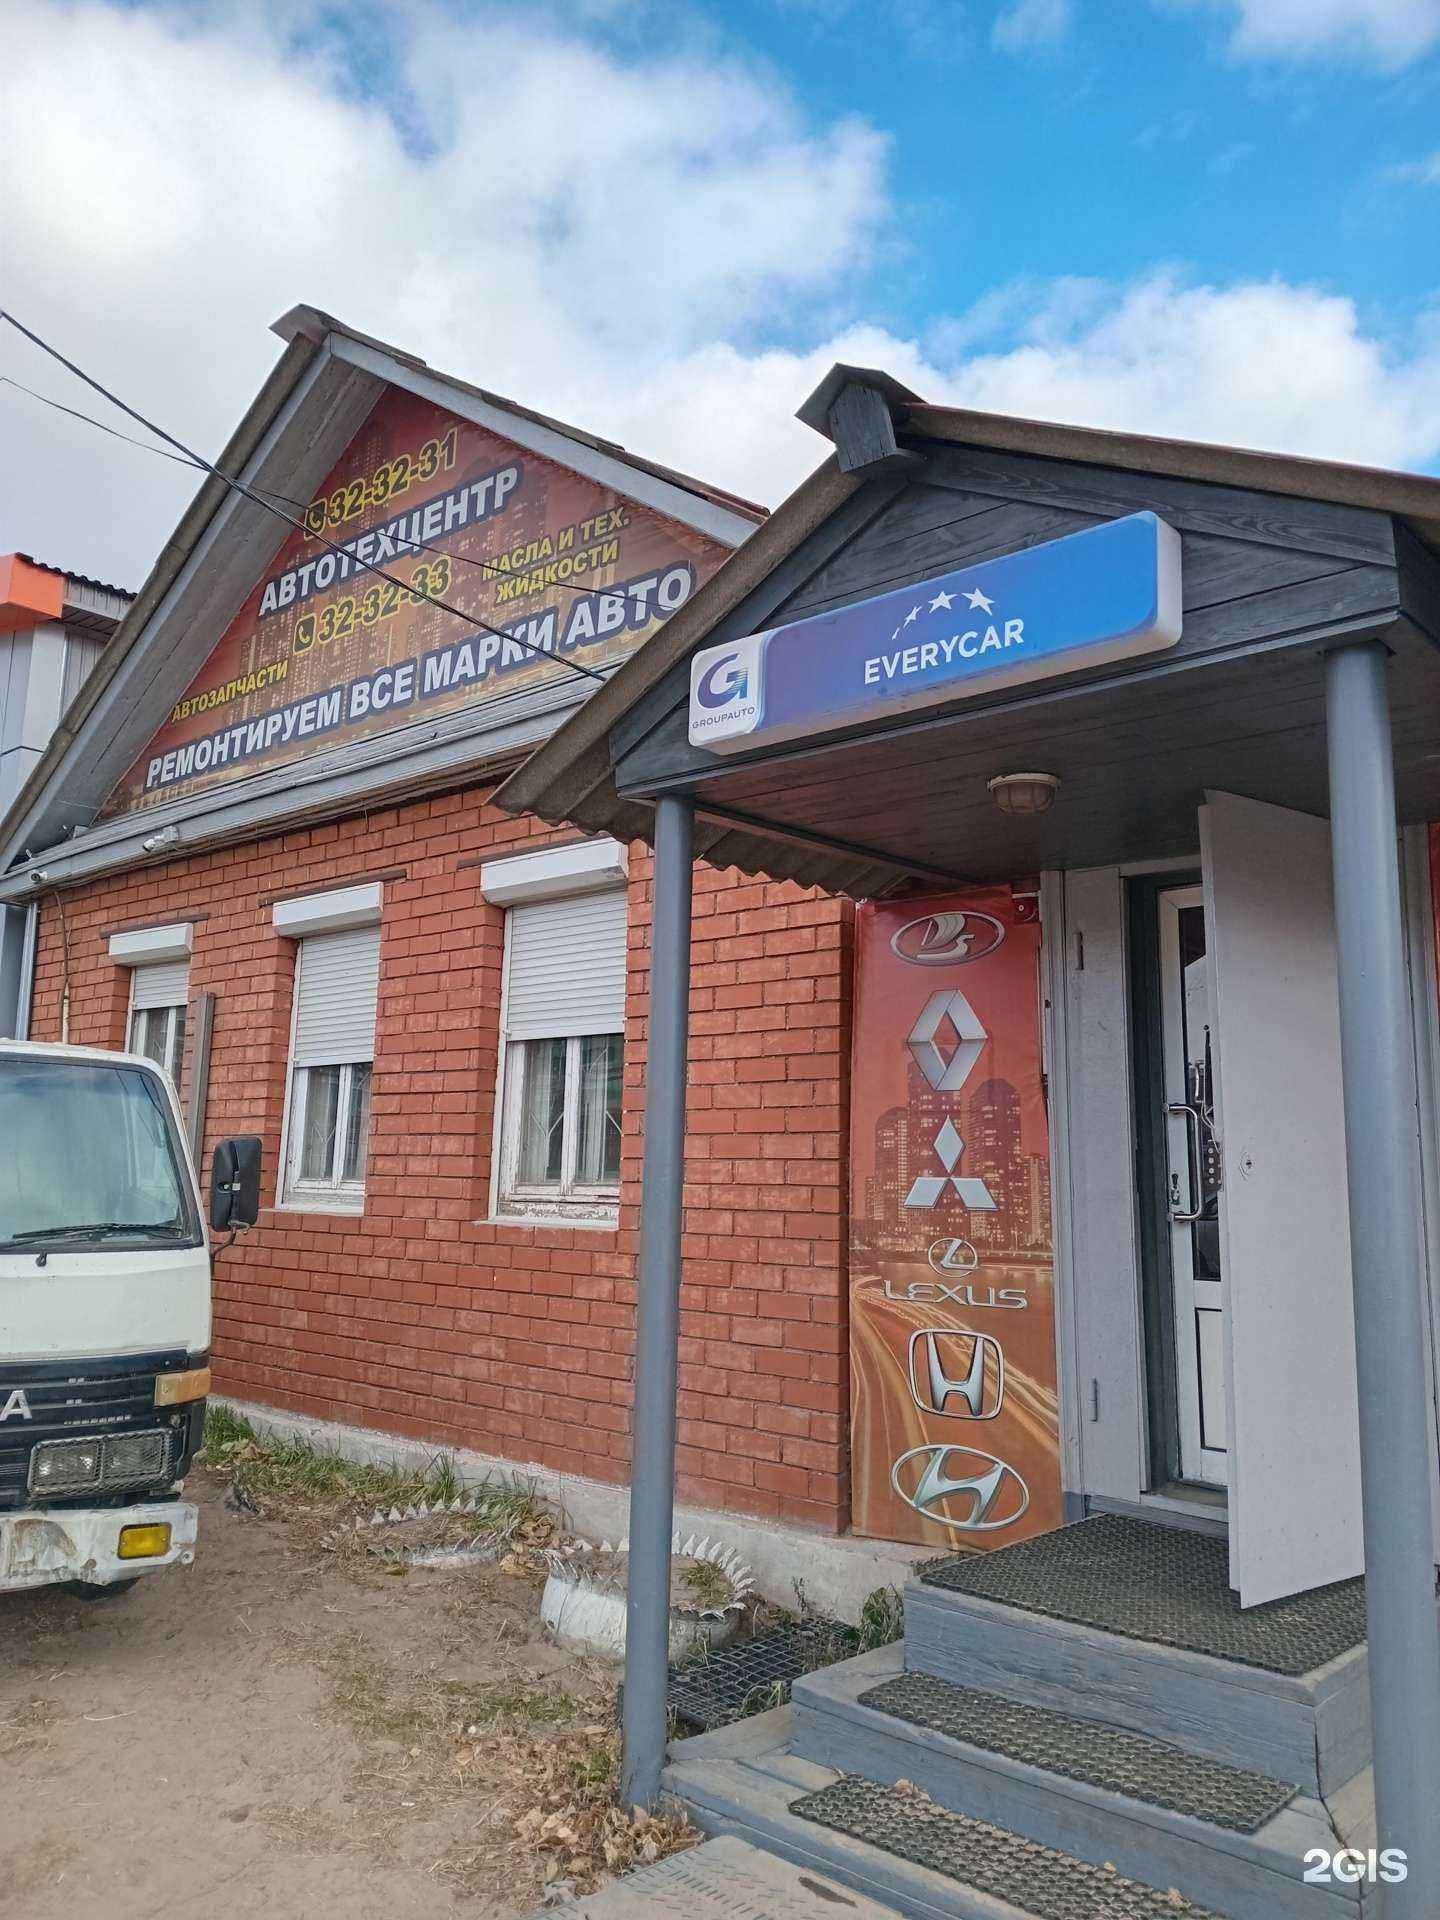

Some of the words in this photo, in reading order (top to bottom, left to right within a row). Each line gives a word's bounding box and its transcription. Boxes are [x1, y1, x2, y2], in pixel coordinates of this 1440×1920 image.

[327, 427, 458, 528] 32-32-31
[258, 466, 519, 617] АВТОТЕХЦЕНТР
[482, 537, 552, 580] МАСЛА
[558, 527, 575, 550] И
[581, 506, 630, 541] ТЕХ.
[496, 539, 619, 603] ЖИДКОСТИ
[317, 554, 452, 644] 32-32-33
[146, 690, 341, 788] РЕМОНТИРУЕМ
[350, 664, 415, 718] ВСЕ
[423, 613, 555, 693] МАРКИ
[565, 568, 692, 646] АВТО
[864, 618, 1024, 685] EVERYCAR
[171, 659, 289, 723] АВТОЗАПЧАСТИ
[692, 706, 755, 729] GROUPAUTO
[884, 1280, 1028, 1309] LEXUS
